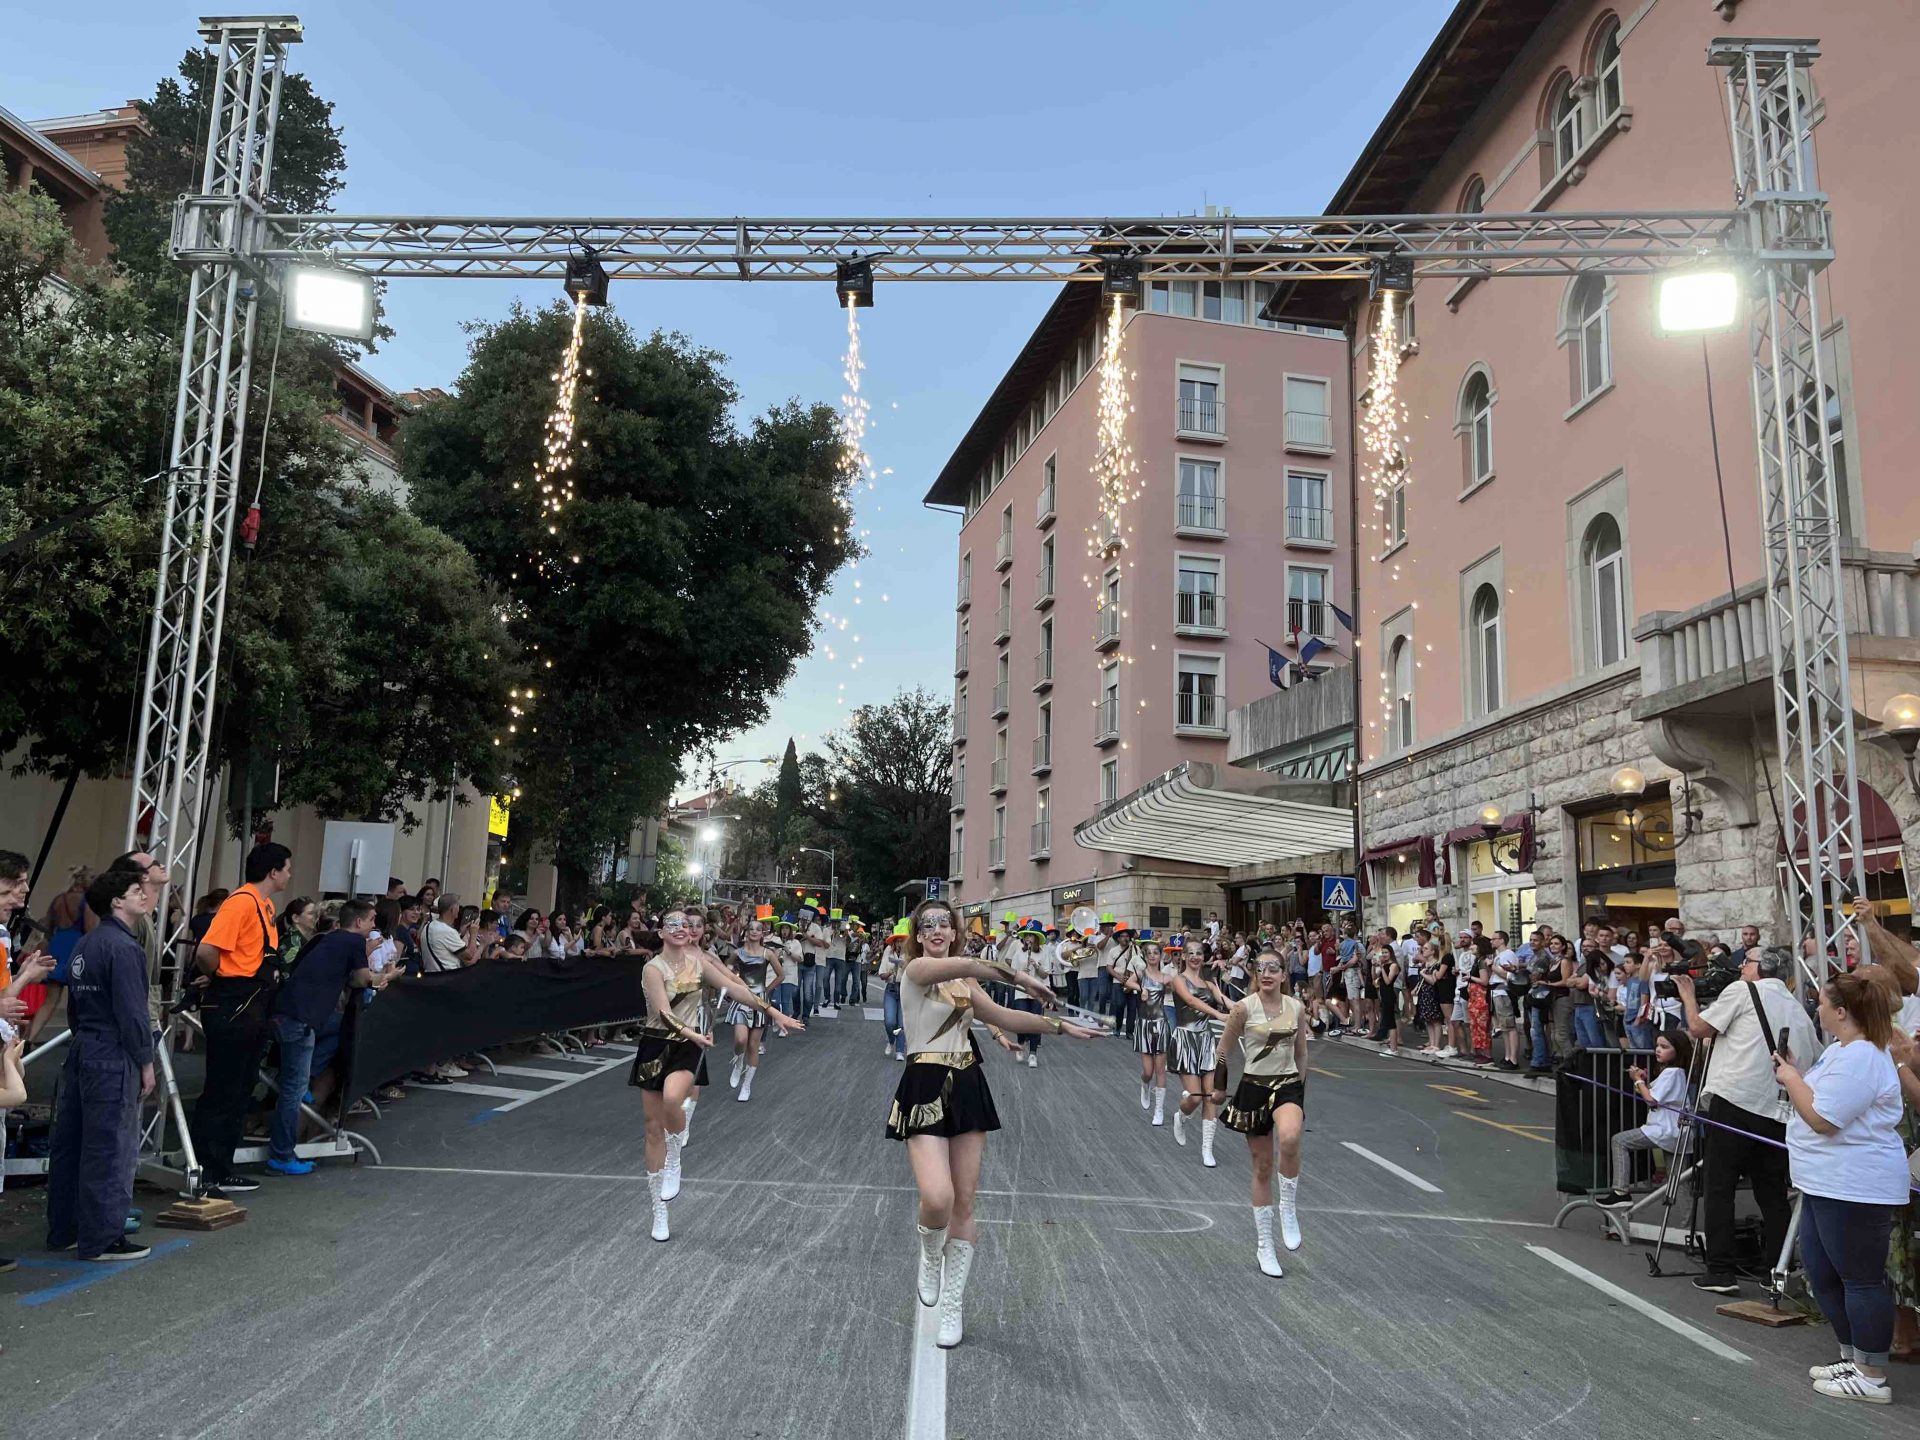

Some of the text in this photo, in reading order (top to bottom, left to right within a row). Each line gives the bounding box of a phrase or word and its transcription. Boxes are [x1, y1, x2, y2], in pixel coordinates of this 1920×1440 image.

[930, 884, 937, 893] P
[1063, 888, 1082, 900] GANT
[969, 905, 982, 914] GANT
